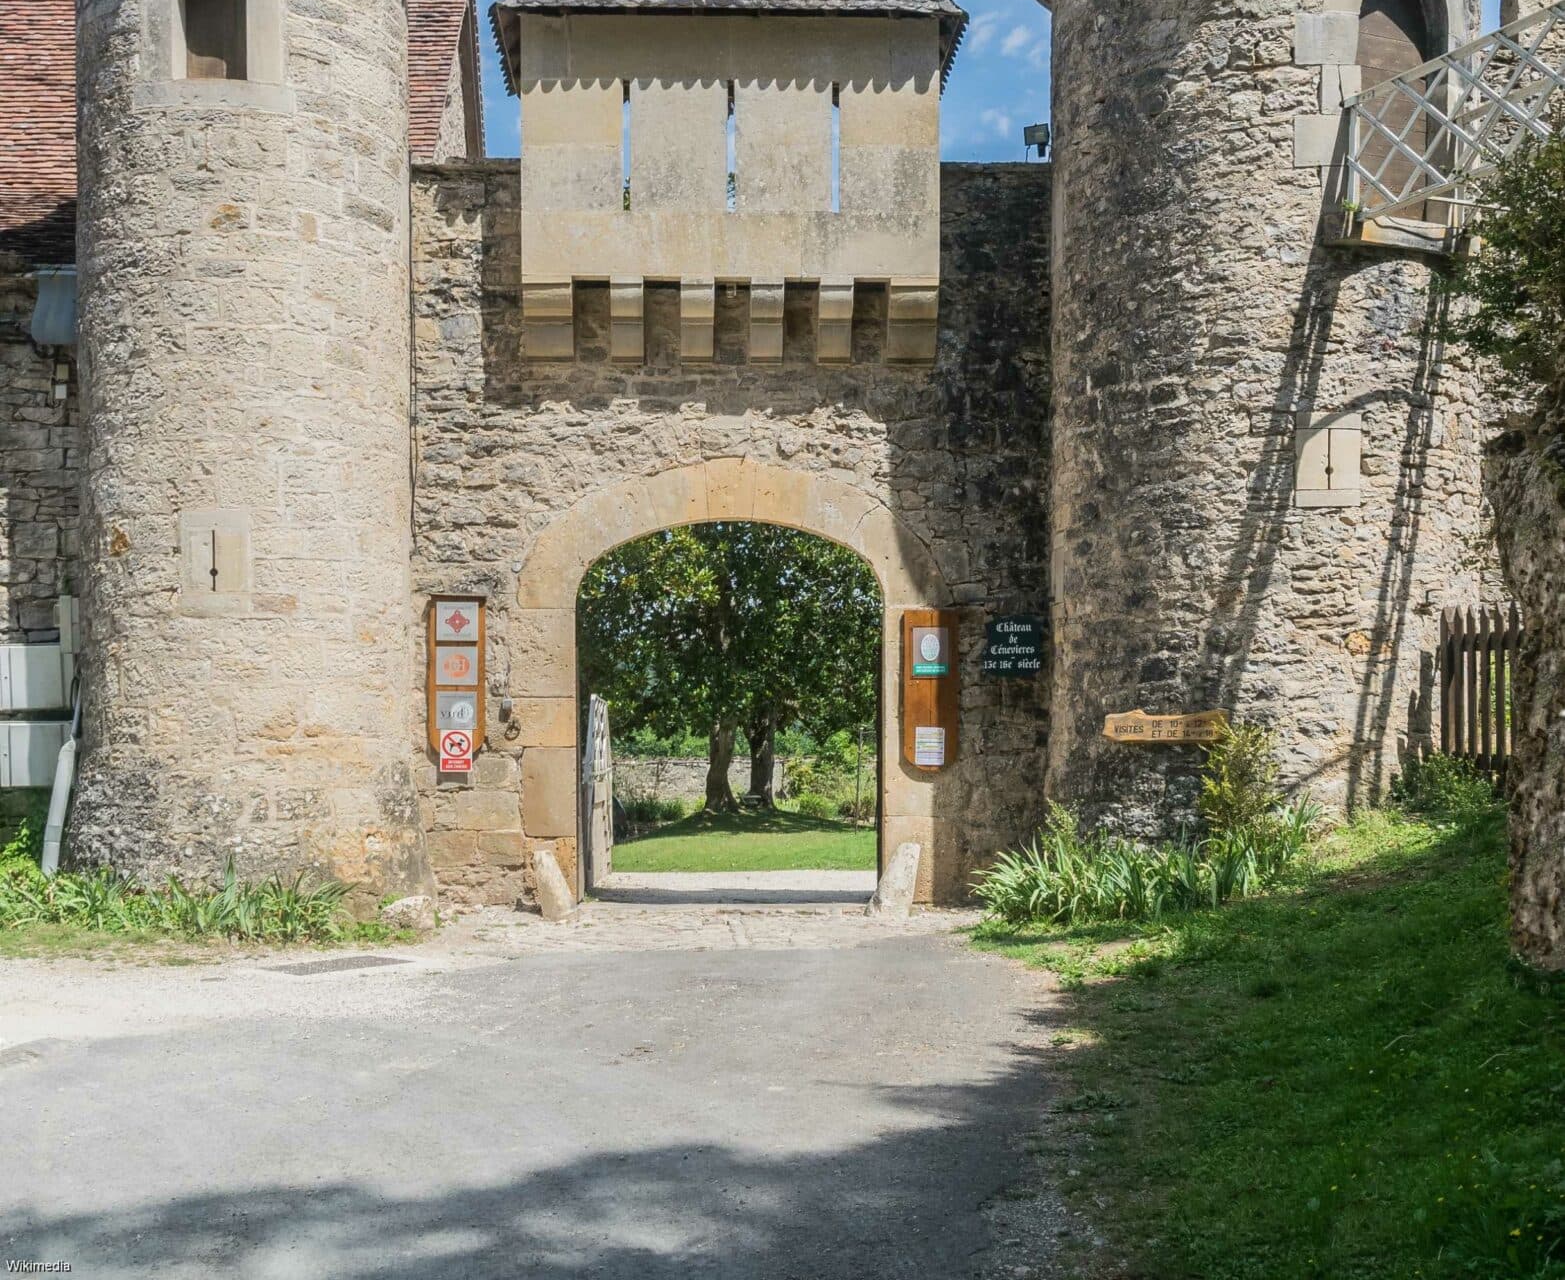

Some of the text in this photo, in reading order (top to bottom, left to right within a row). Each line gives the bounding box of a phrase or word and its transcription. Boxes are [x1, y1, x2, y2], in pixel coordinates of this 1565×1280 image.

[996, 621, 1032, 632] Château
[1009, 633, 1018, 644] de
[1152, 720, 1163, 728] DE
[1152, 730, 1161, 738] ET
[1167, 730, 1178, 738] DE
